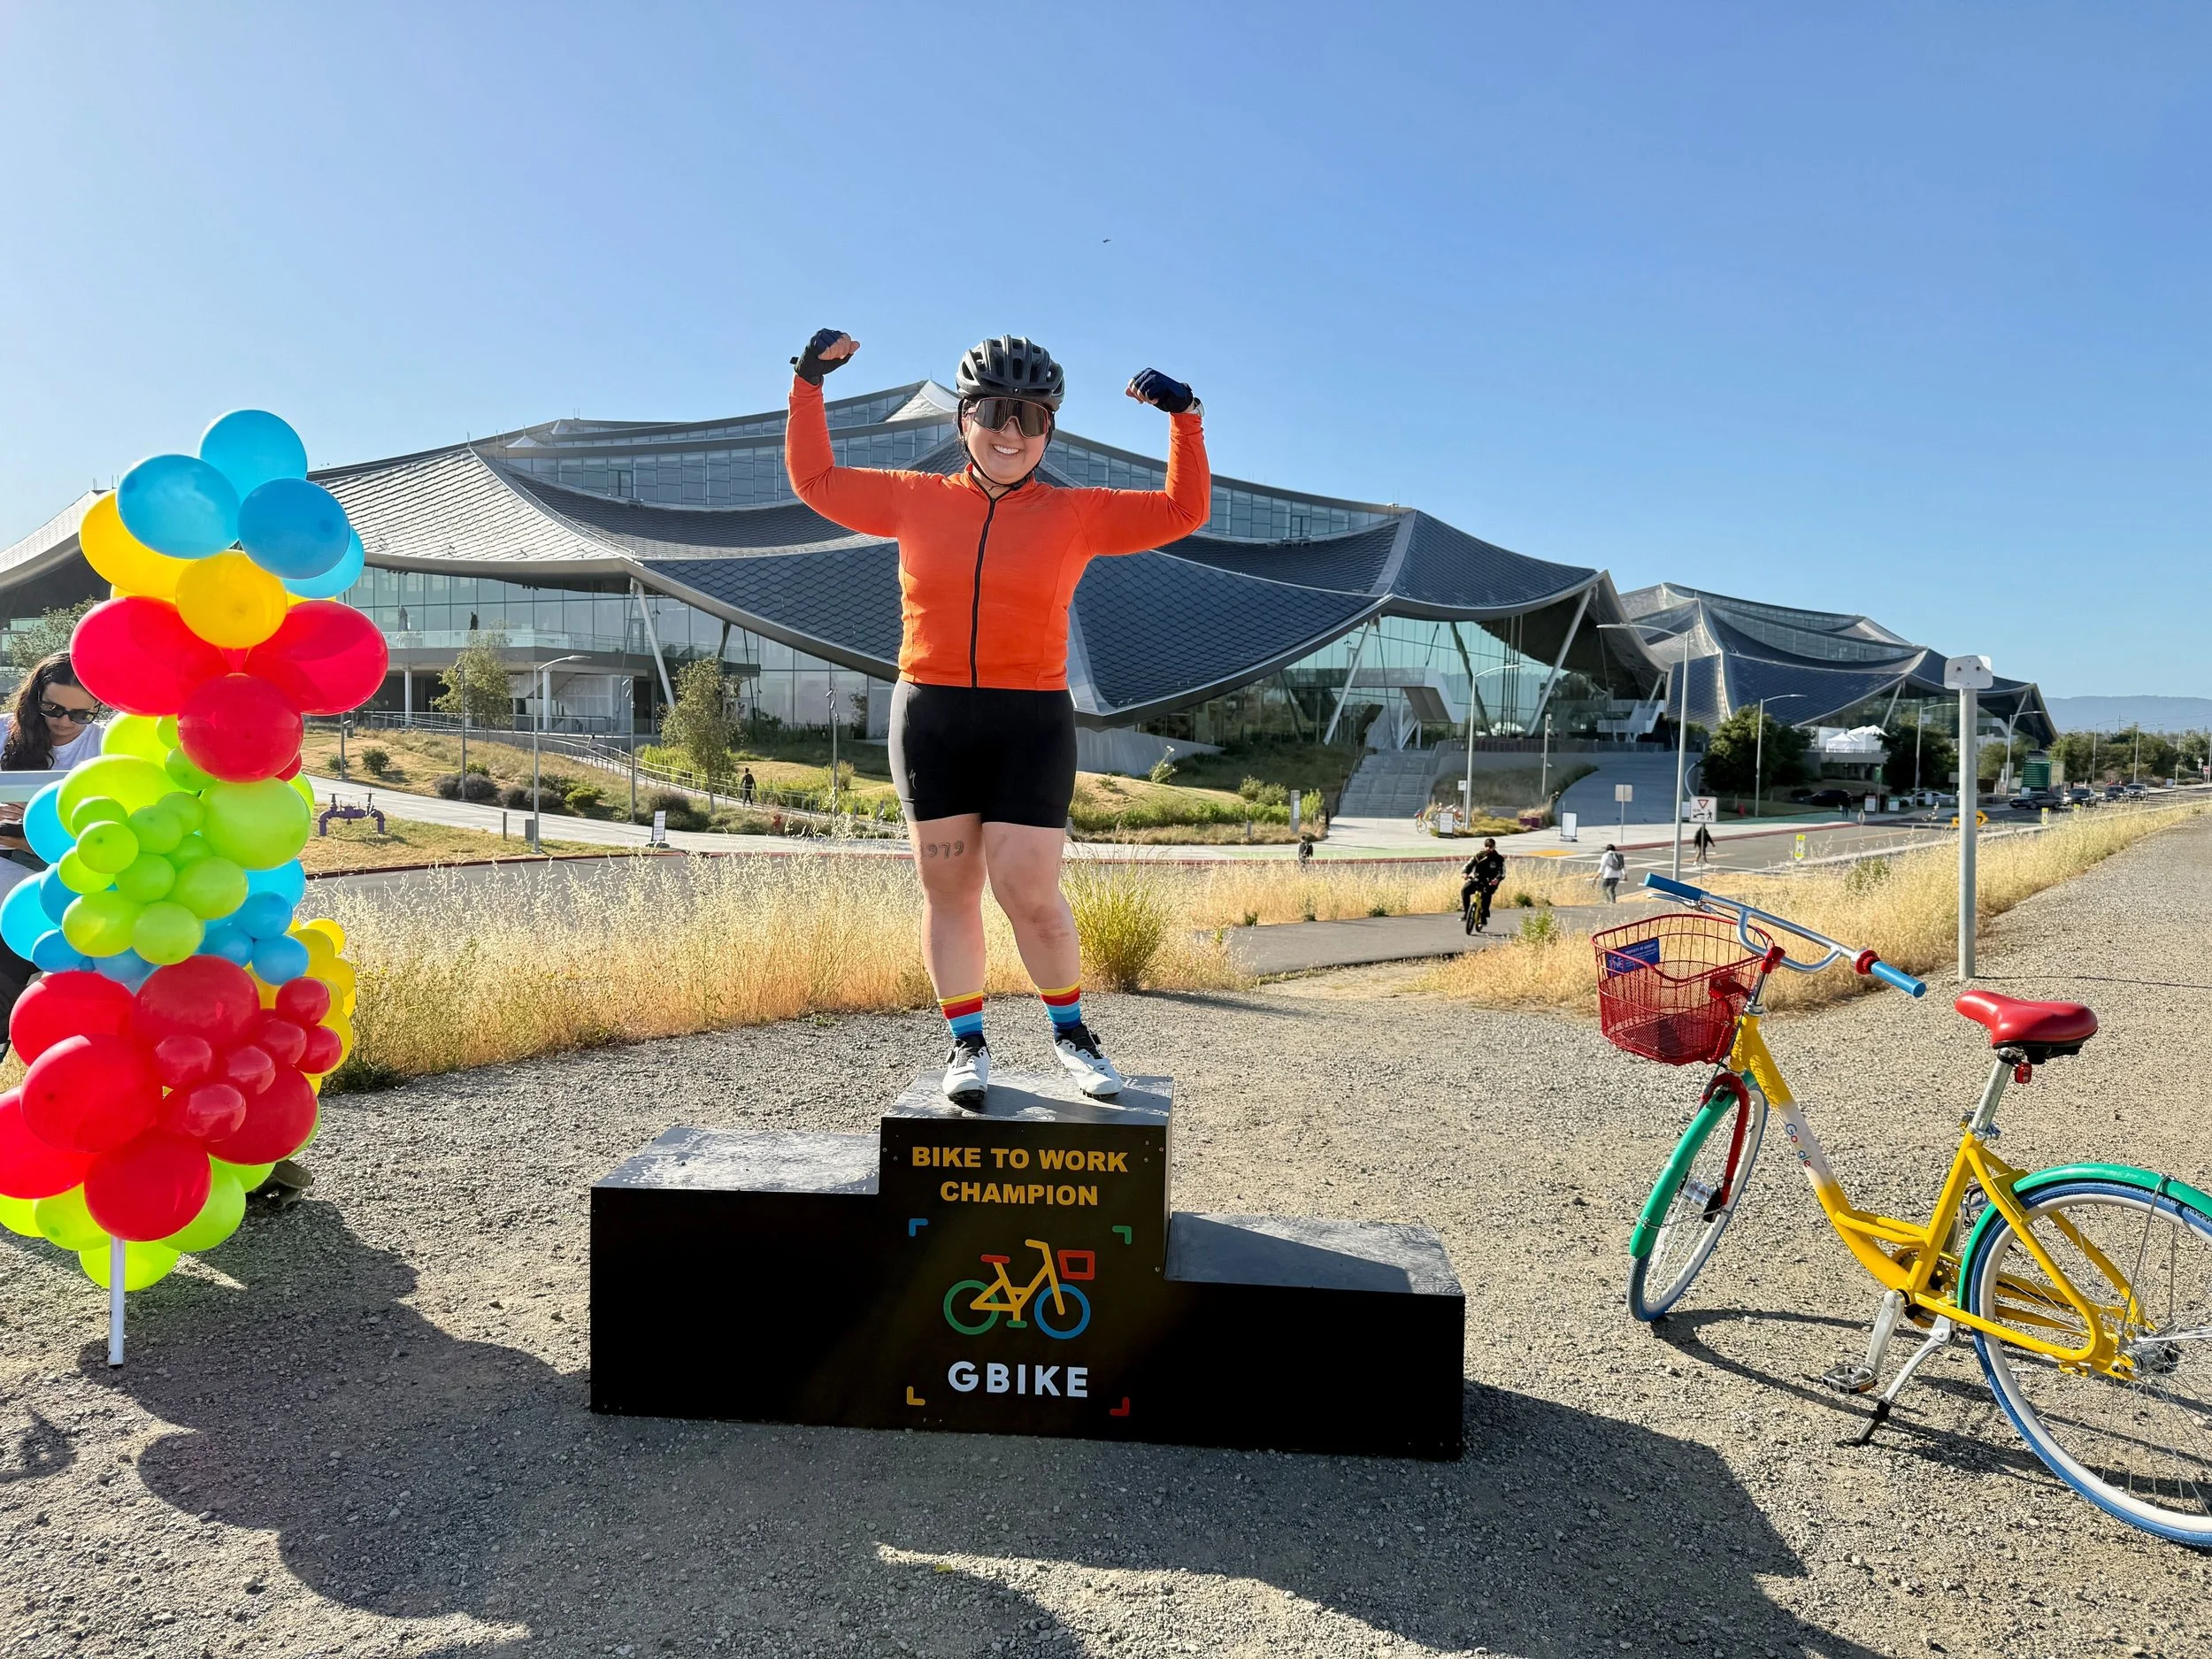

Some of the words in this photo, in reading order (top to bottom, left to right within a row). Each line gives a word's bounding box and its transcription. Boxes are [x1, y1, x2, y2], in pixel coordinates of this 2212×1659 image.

[913, 1147, 980, 1167] BIKE
[991, 1148, 1029, 1169] TO
[1039, 1149, 1128, 1172] WORK
[941, 1181, 1097, 1205] CHAMPION
[949, 1362, 1087, 1397] GBIKE
